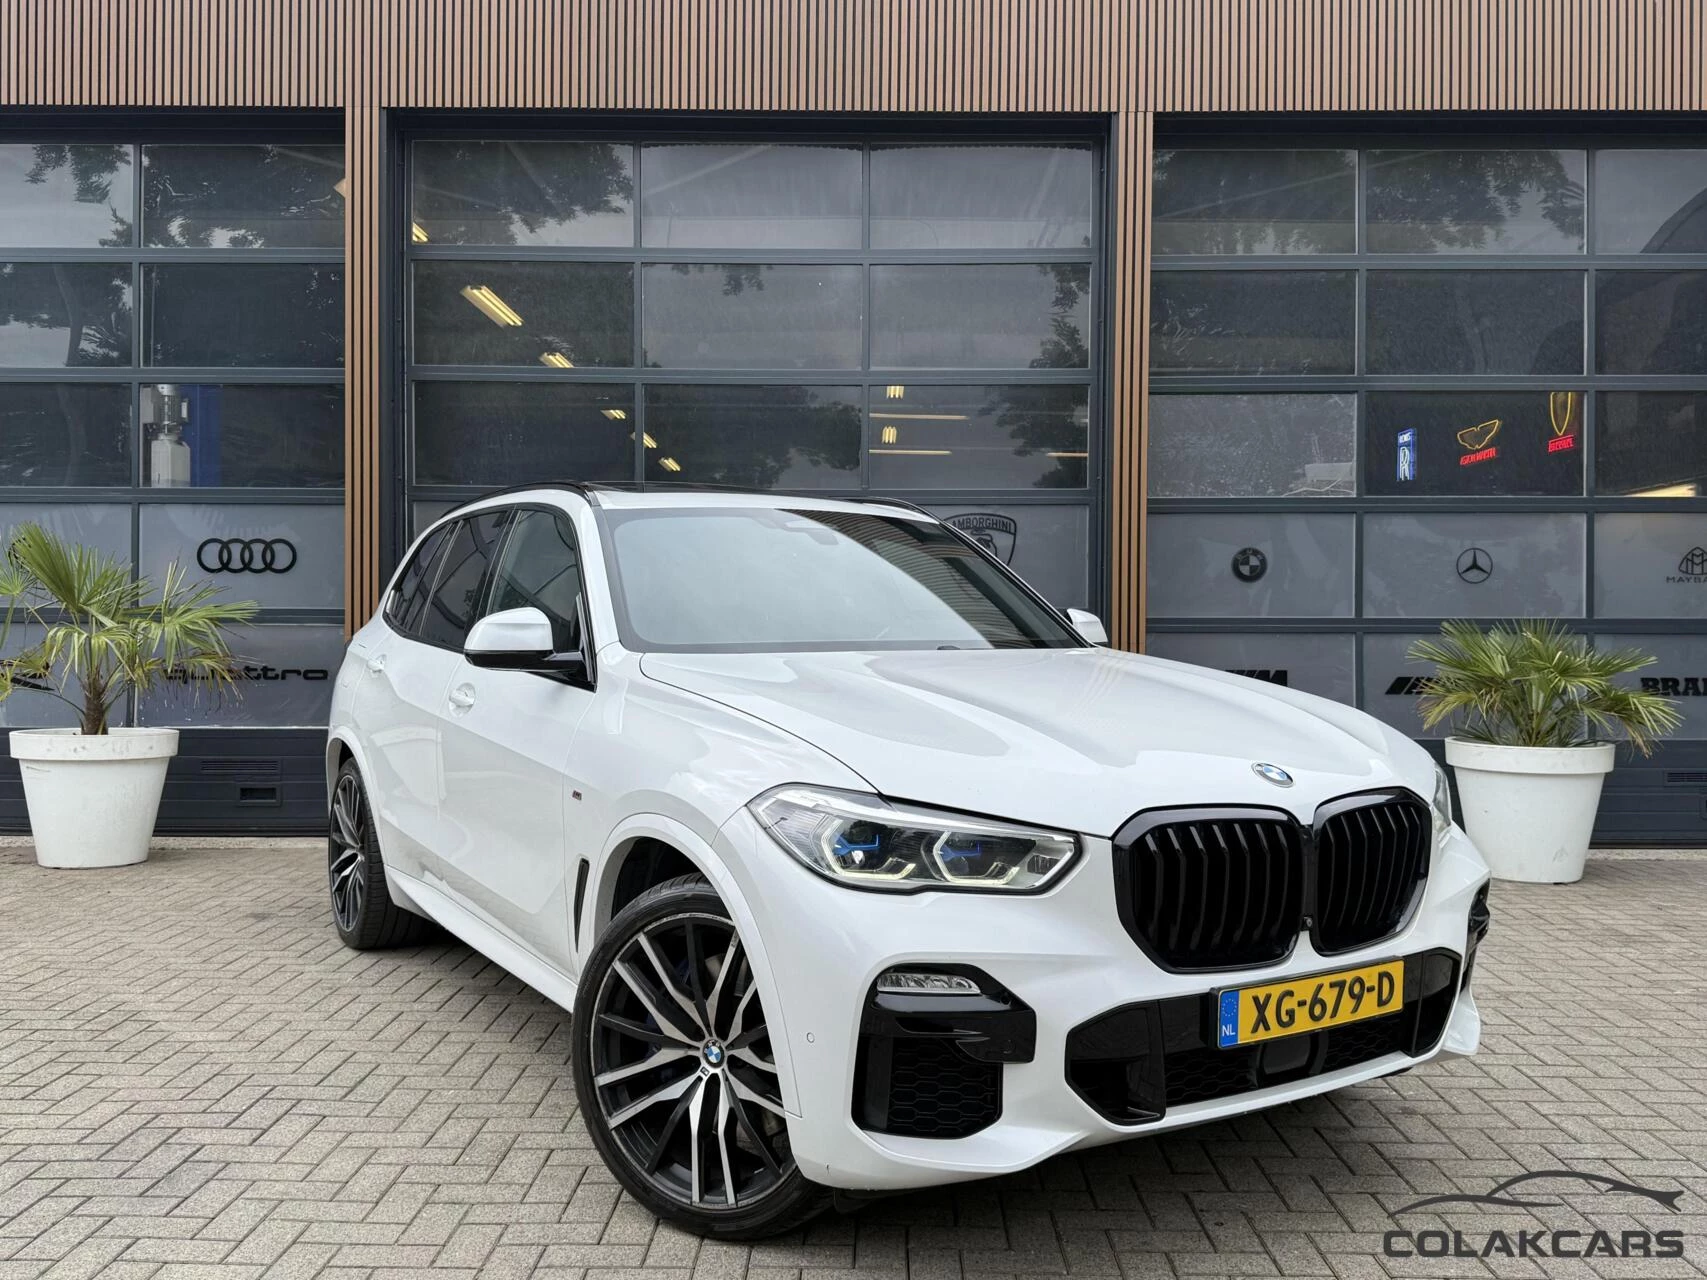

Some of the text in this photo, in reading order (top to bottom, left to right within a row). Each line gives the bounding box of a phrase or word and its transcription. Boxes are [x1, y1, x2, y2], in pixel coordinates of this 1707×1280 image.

[950, 517, 1012, 532] AMBORGHINI
[1640, 677, 1707, 696] BRA
[1251, 970, 1395, 1034] XG-679-D
[1221, 1024, 1236, 1037] NL
